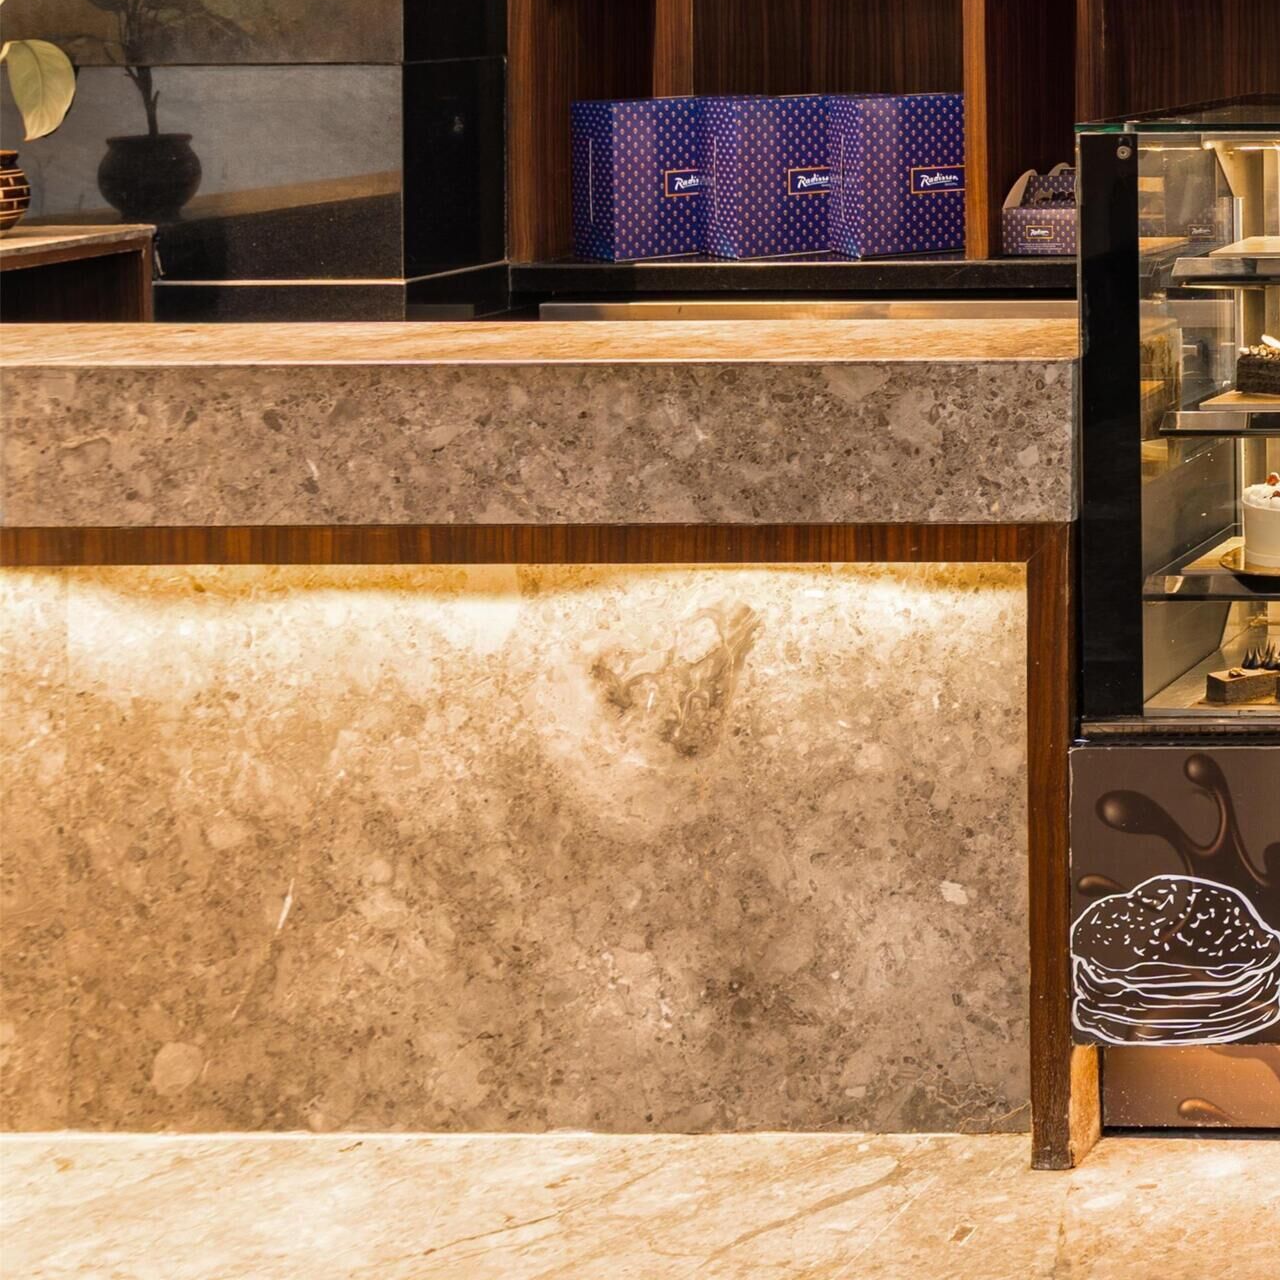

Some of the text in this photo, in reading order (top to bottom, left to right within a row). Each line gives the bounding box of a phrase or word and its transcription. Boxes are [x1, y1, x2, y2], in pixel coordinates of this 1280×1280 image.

[674, 174, 699, 191] Radis
[797, 173, 830, 189] Radisso
[920, 172, 959, 188] Radisson
